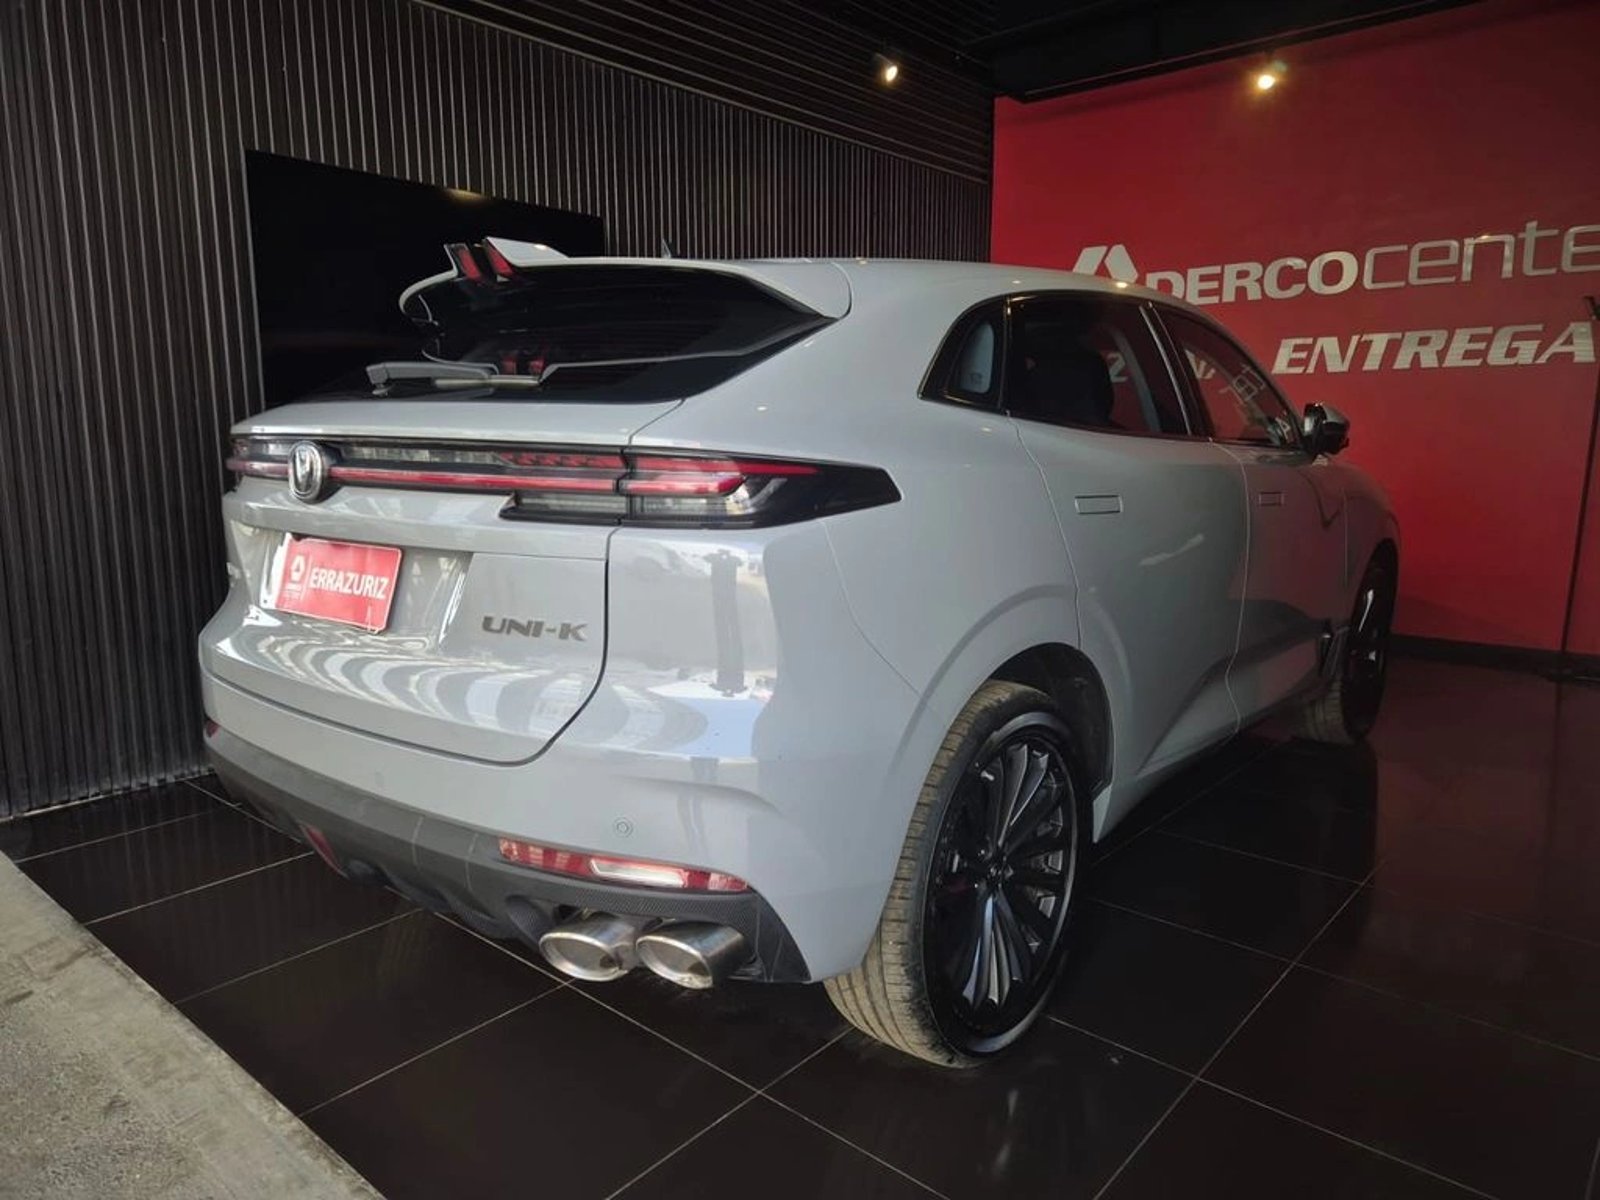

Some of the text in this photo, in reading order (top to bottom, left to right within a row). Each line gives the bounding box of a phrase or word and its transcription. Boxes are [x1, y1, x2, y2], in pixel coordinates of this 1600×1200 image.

[1271, 321, 1597, 375] ENTREGA
[309, 567, 390, 599] ERRAZURIZ
[482, 616, 588, 641] UNI-K
